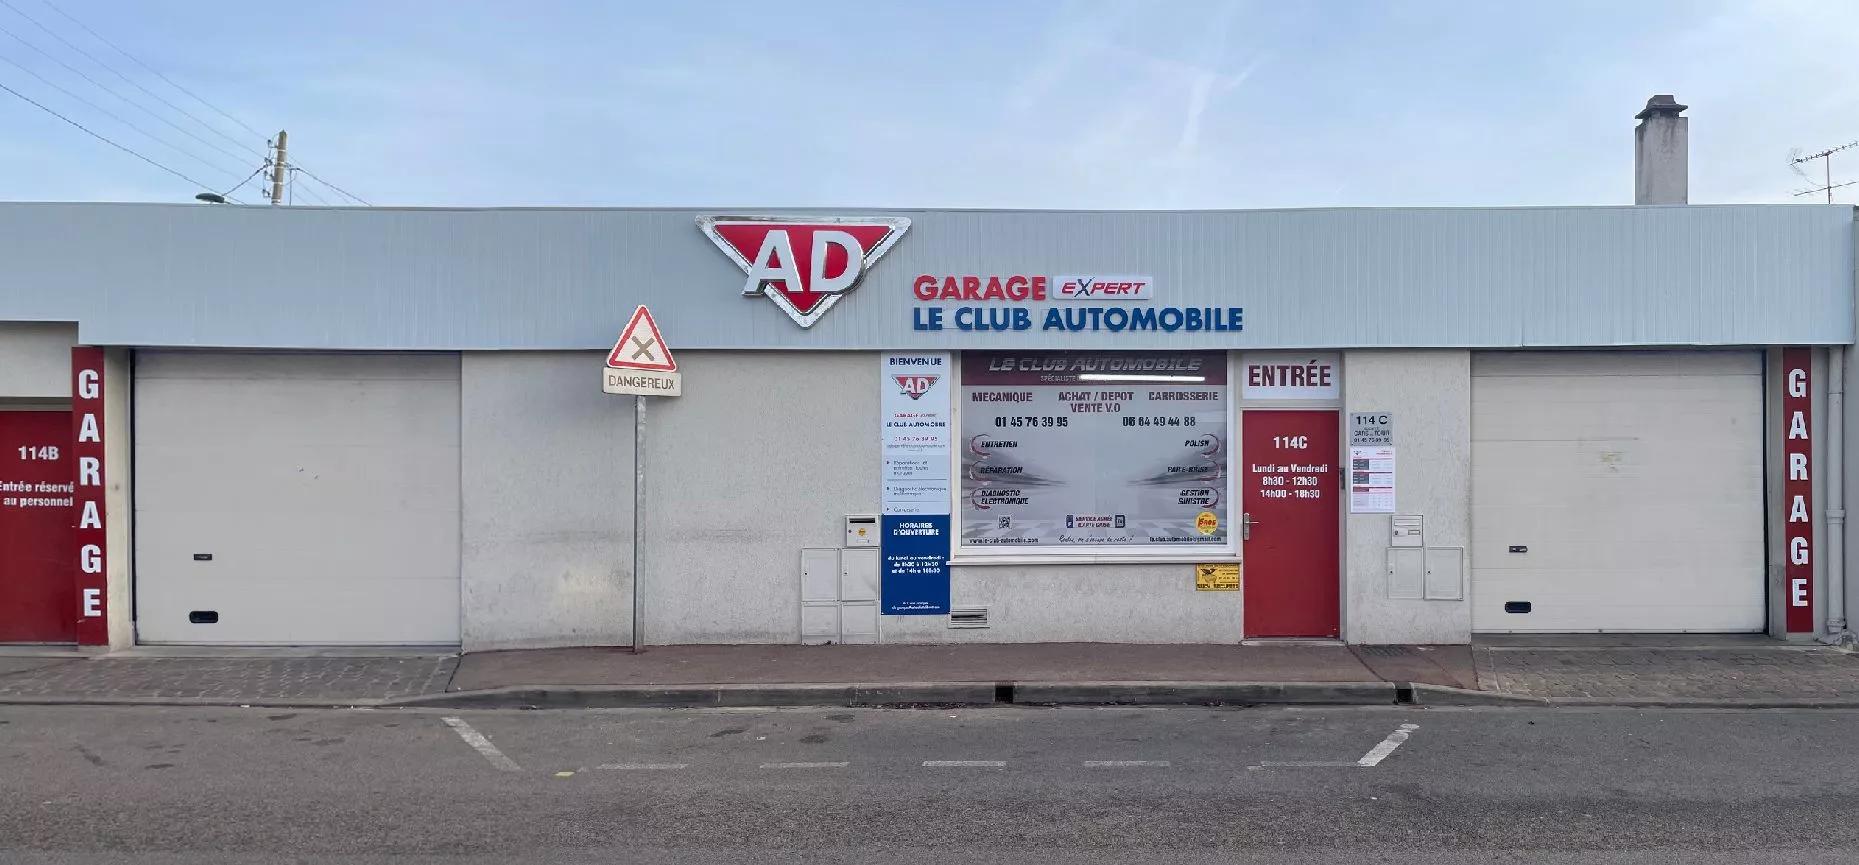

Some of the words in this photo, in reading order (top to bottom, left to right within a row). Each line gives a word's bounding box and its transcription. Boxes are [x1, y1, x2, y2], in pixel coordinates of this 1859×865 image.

[742, 229, 866, 296] AD
[913, 275, 1046, 301] GARAGE
[913, 307, 943, 331] LE
[954, 306, 1032, 331] CLUB
[1042, 306, 1243, 332] AUTOMOBILE
[889, 357, 942, 366] BIENVENUE
[989, 358, 1016, 371] LE
[1019, 358, 1069, 371] CLUB
[1069, 358, 1203, 371] AUTOMOBILE
[1248, 359, 1331, 387] ENTRÉE
[608, 375, 675, 390] DANGEREUX
[903, 377, 929, 394] AD
[972, 392, 1033, 403] MECANIQUE
[1058, 391, 1092, 401] ACHAT
[1101, 391, 1135, 401] DEPOT
[1148, 391, 1219, 401] CARROSSERIE
[1070, 402, 1103, 413] VENTE
[995, 416, 1007, 427] 01
[1010, 416, 1023, 427] 45
[1024, 416, 1039, 427] 76
[1041, 416, 1054, 427] 39
[1056, 416, 1068, 427] 95
[1153, 416, 1166, 427] 49
[1167, 416, 1180, 427] 44
[1183, 416, 1196, 427] 88
[1356, 415, 1376, 425] 114
[1378, 415, 1388, 425] C
[1273, 436, 1308, 449] 114C
[18, 446, 59, 460] 114B
[980, 466, 1023, 474] RÉPARATION
[1252, 463, 1275, 473] Lundi
[1277, 465, 1289, 473] au
[1290, 463, 1328, 473] Vendredi
[1262, 476, 1284, 486] 8h30
[1292, 476, 1318, 486] 12h30
[35, 481, 74, 493] réservé
[78, 368, 102, 617] GARAGE
[1788, 368, 1809, 607] GARAGE
[1180, 489, 1210, 497] GESTION
[1260, 489, 1287, 499] 14h00
[3, 497, 17, 506] au
[19, 496, 74, 508] personnel
[1178, 497, 1209, 505] SINISTRE
[893, 528, 940, 536] D'OUVERTURE
